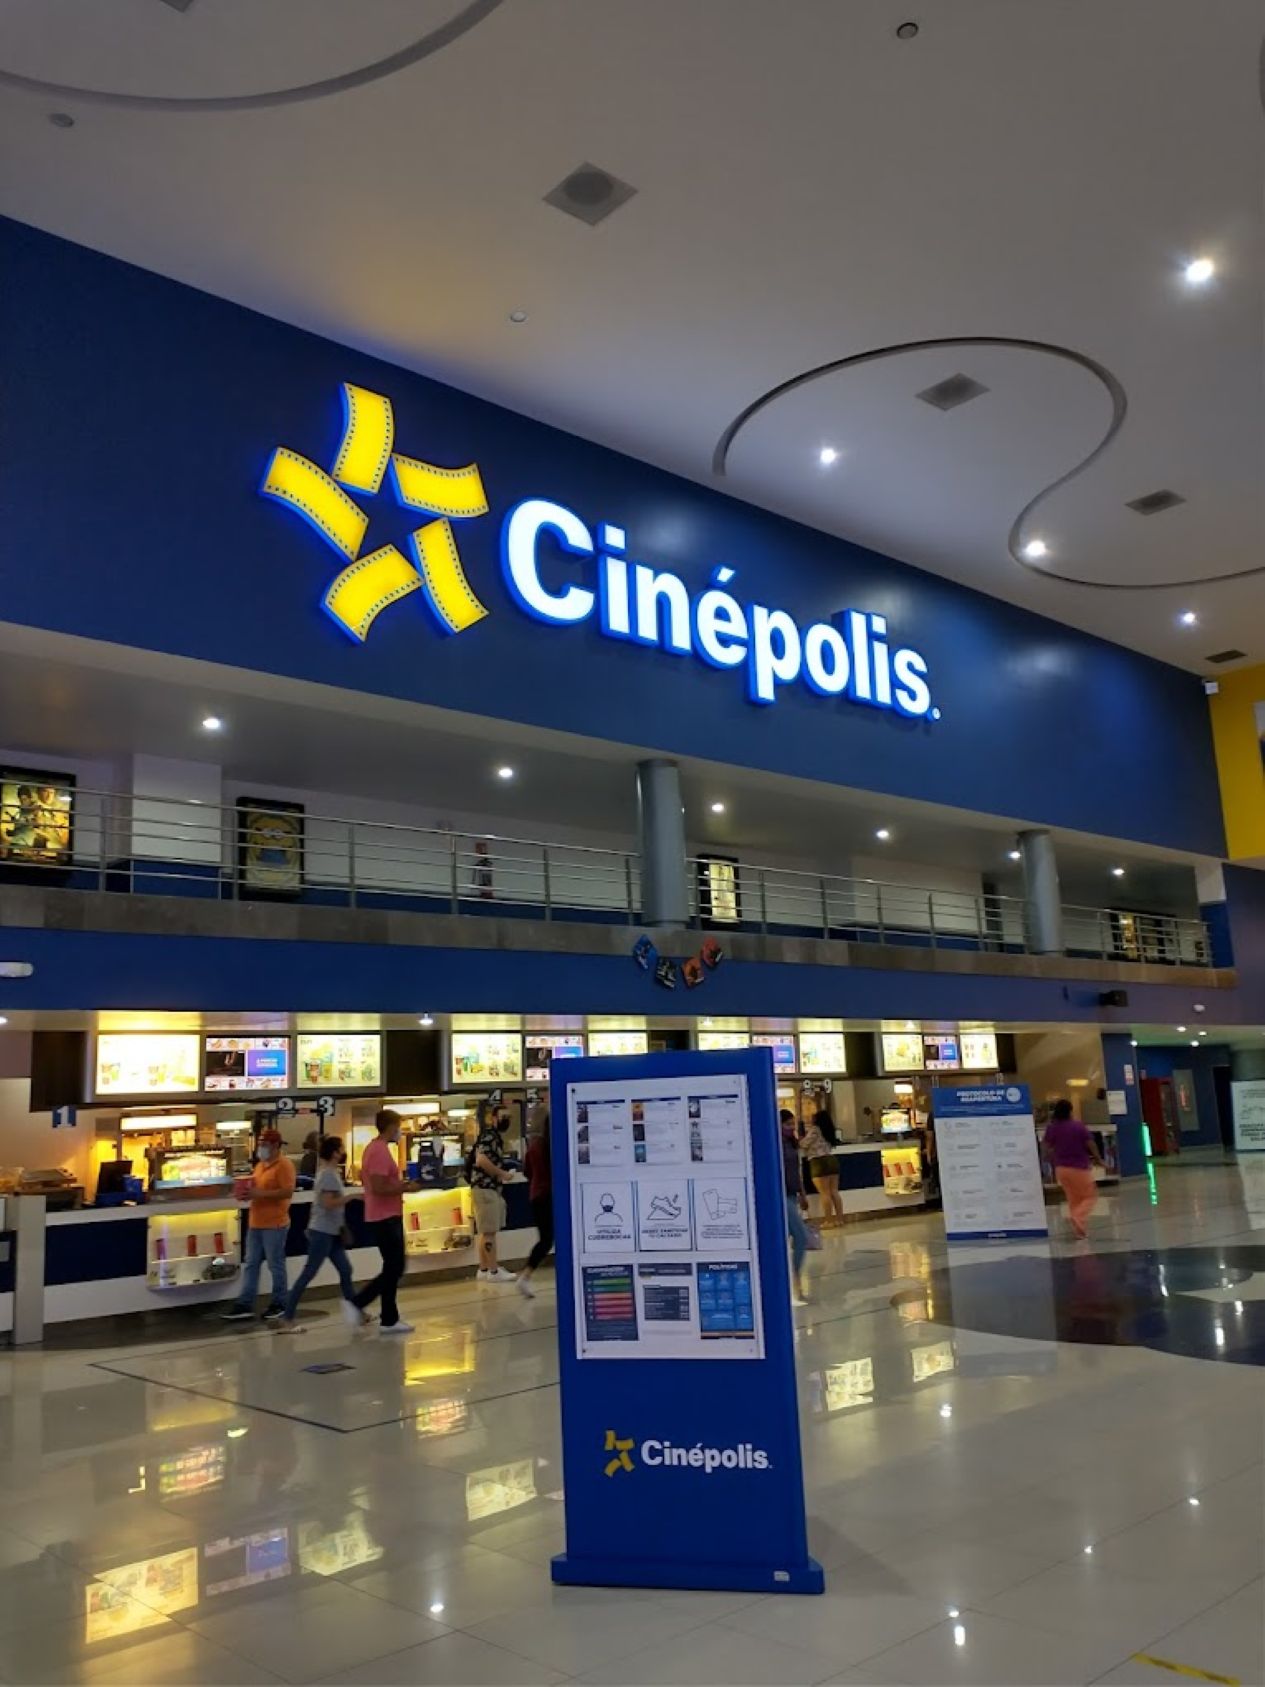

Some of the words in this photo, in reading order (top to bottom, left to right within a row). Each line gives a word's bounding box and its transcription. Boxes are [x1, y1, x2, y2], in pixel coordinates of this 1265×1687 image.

[503, 498, 931, 719] Cinépolis
[56, 1105, 72, 1129] 1
[318, 1096, 334, 1117] 3
[640, 1439, 769, 1474] Cinépolis
